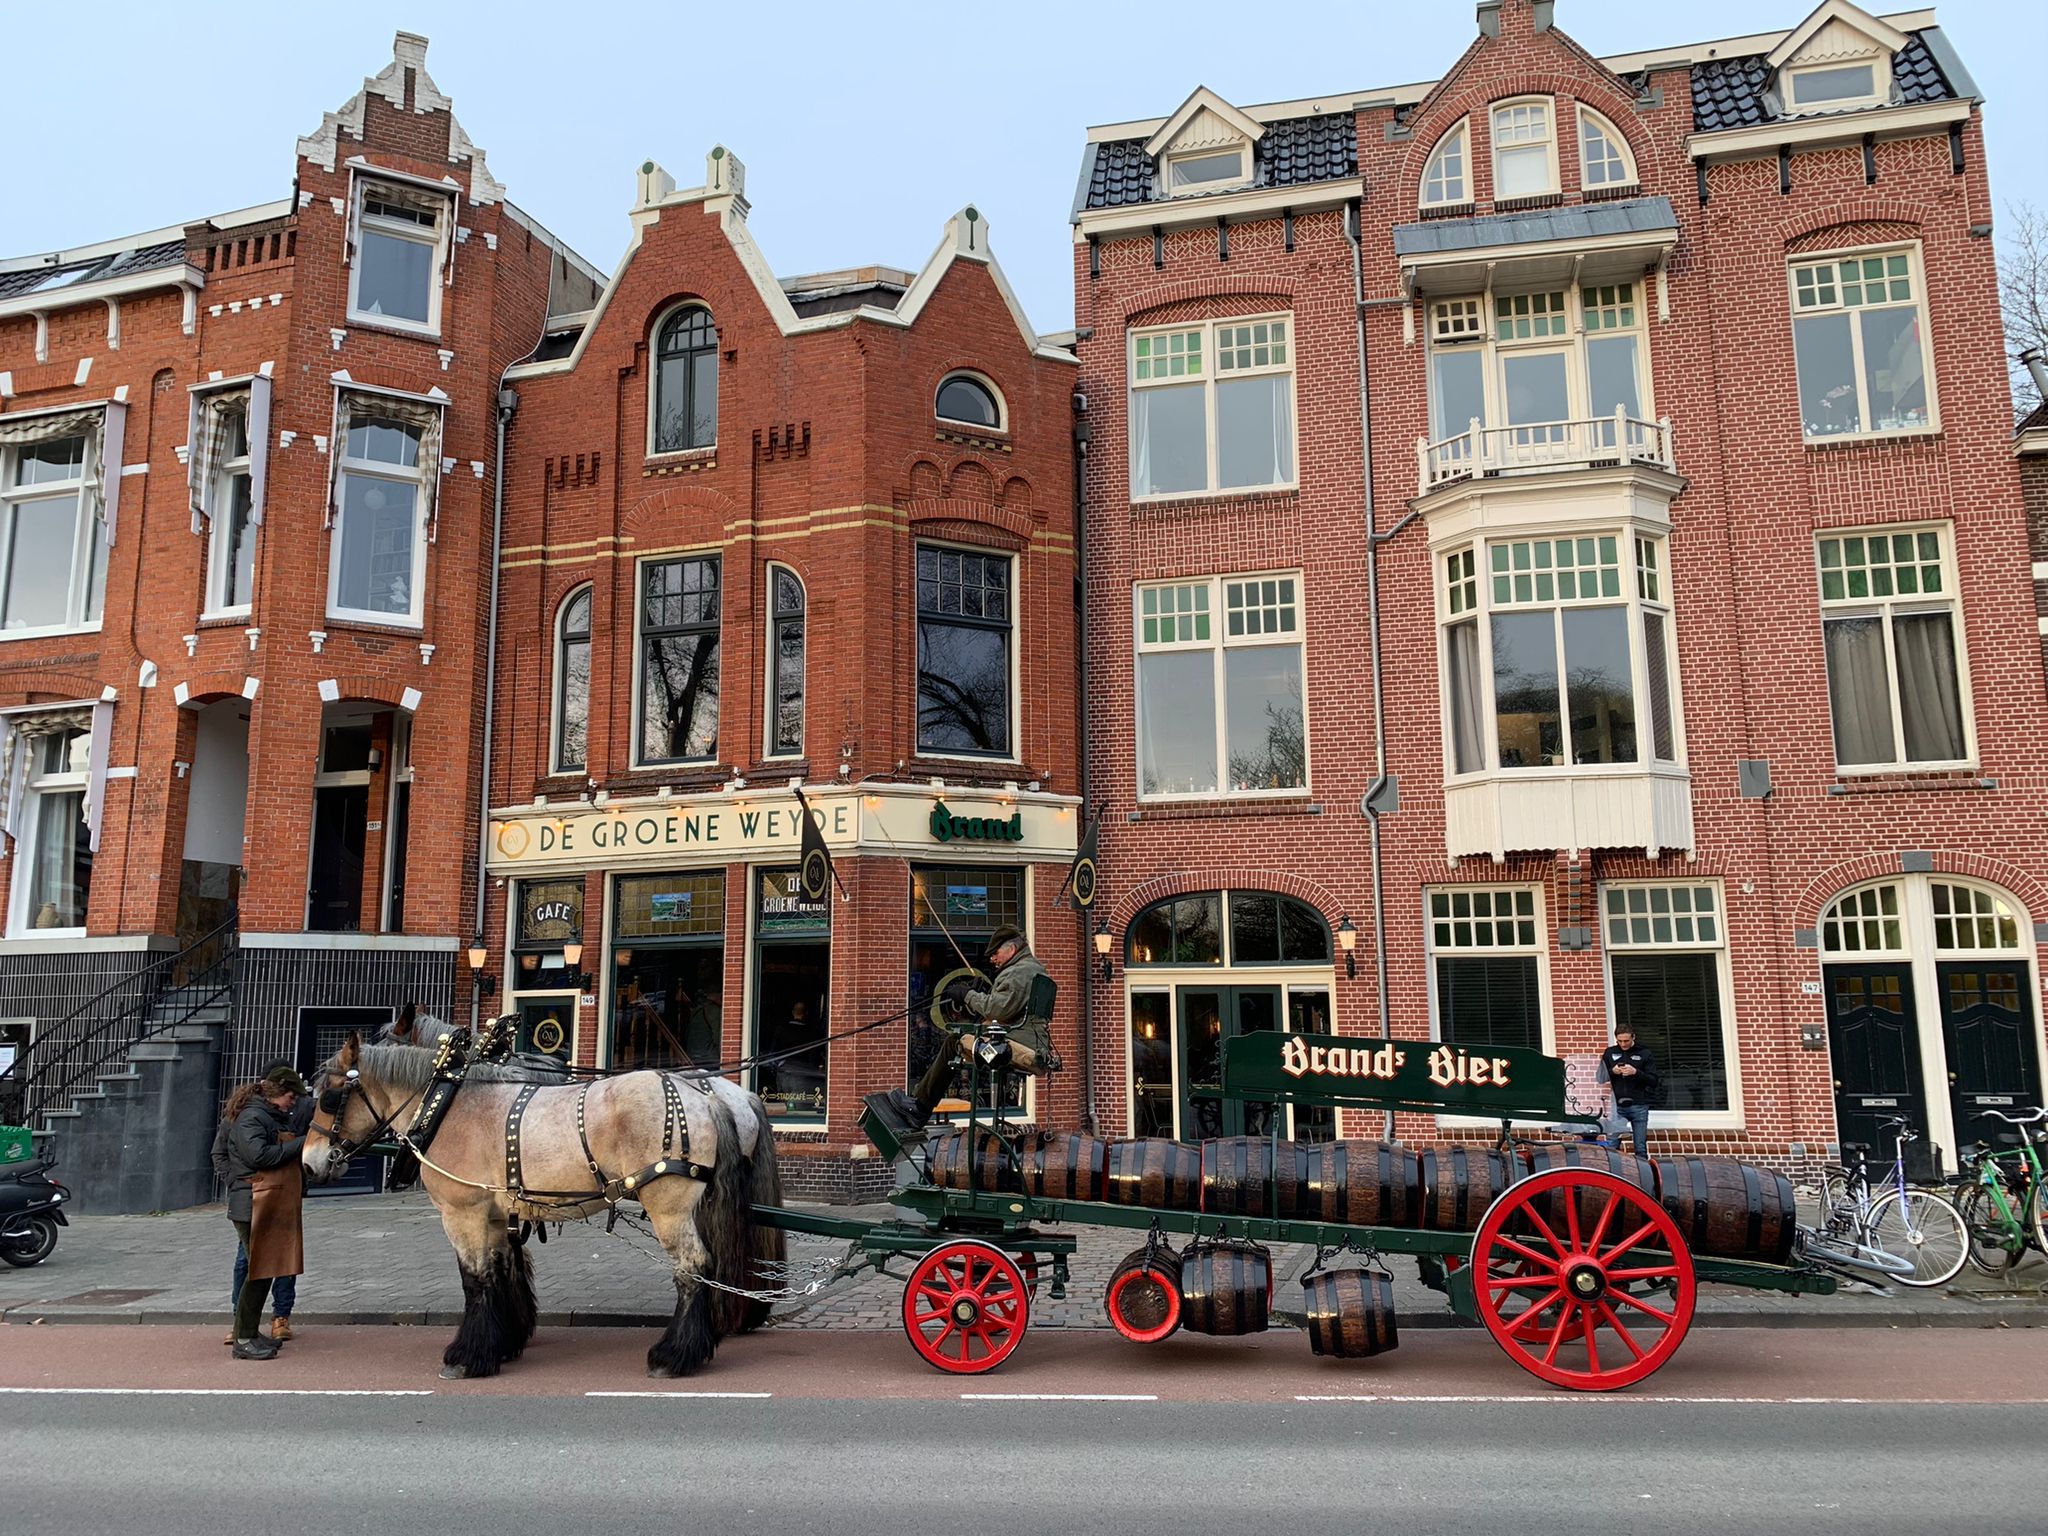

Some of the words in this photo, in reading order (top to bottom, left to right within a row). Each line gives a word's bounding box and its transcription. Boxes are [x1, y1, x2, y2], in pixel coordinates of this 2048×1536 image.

[540, 823, 574, 851] DE
[592, 814, 720, 848] GROENE
[739, 806, 848, 839] WEYDE
[929, 801, 1024, 842] Brand
[763, 897, 798, 913] GROENE
[1427, 1045, 1511, 1088] Bier
